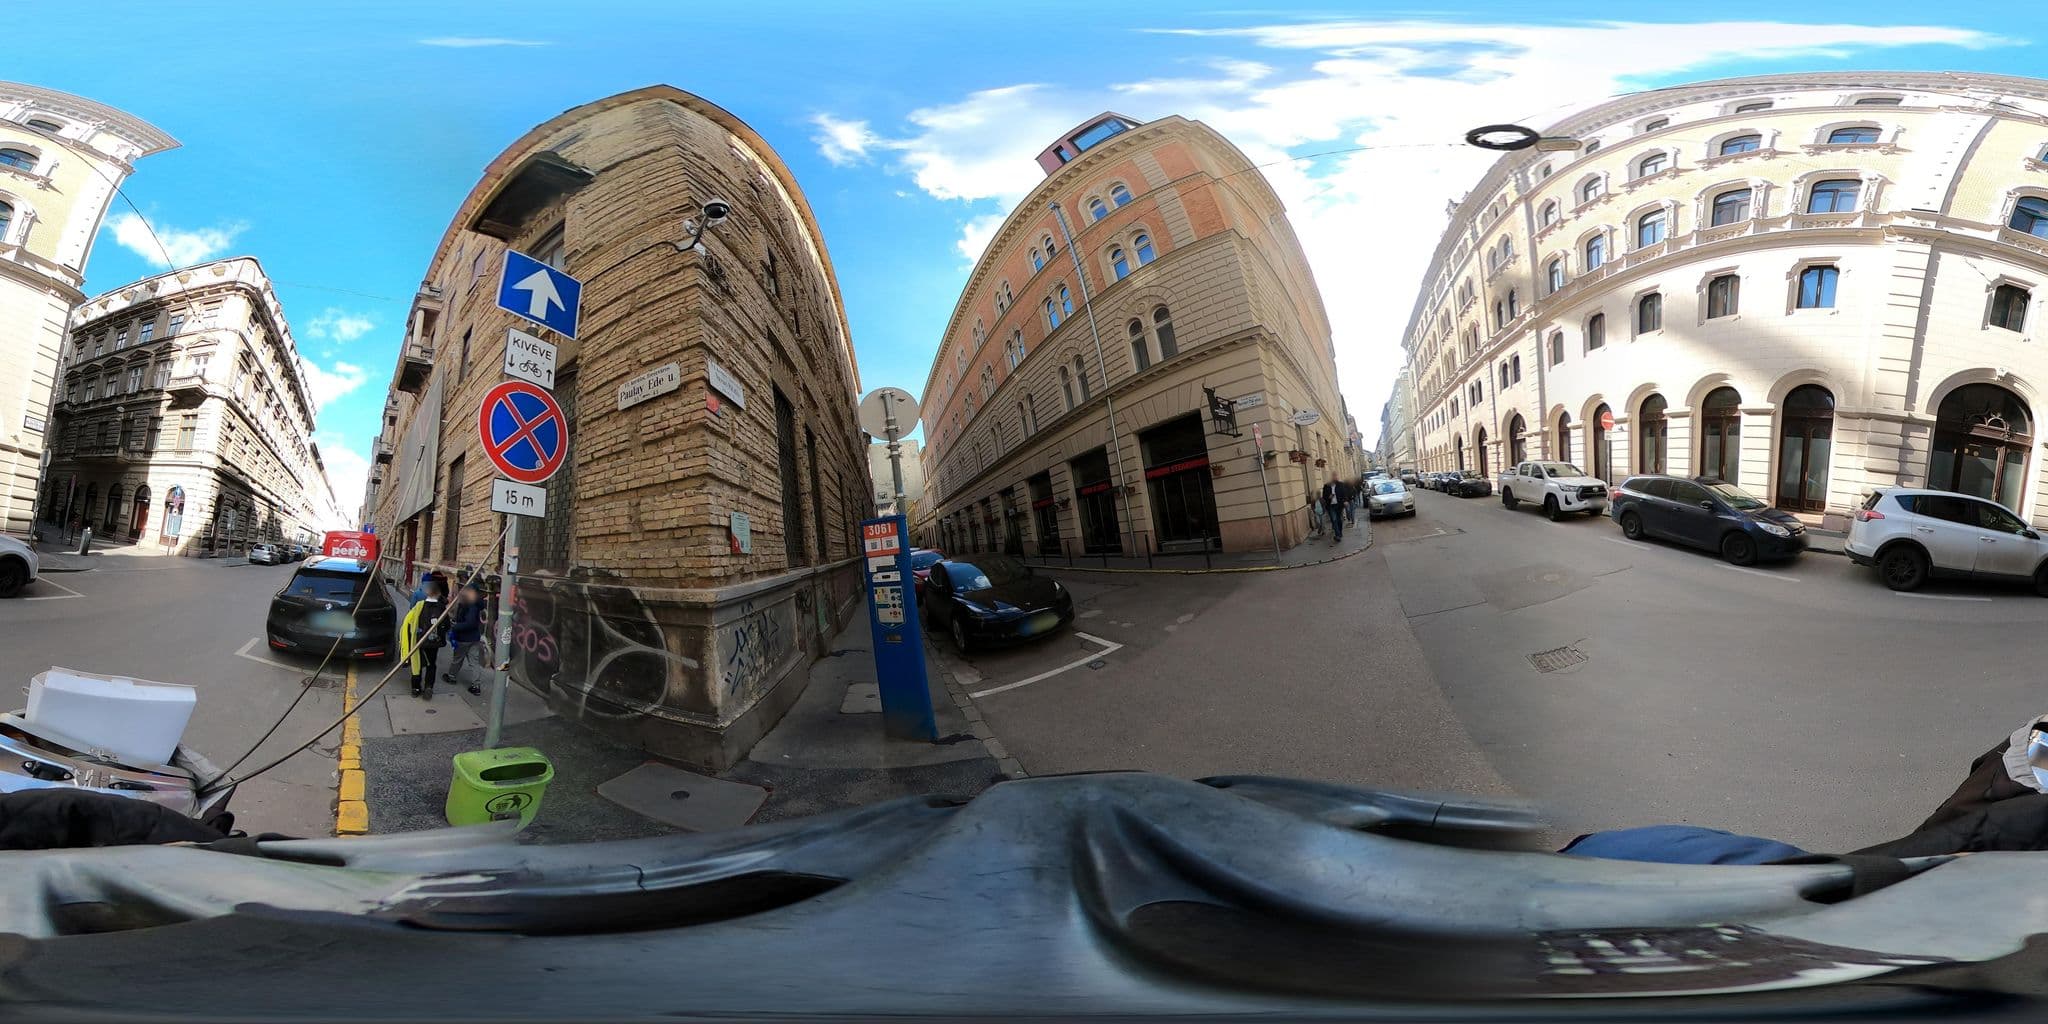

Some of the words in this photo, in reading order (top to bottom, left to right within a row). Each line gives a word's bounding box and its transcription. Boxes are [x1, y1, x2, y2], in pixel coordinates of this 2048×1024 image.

[512, 336, 552, 361] KIVÉVE
[620, 386, 643, 402] Paulay
[648, 376, 664, 390] Ede
[505, 489, 518, 505] 15
[521, 495, 534, 508] m
[868, 522, 893, 536] 3061
